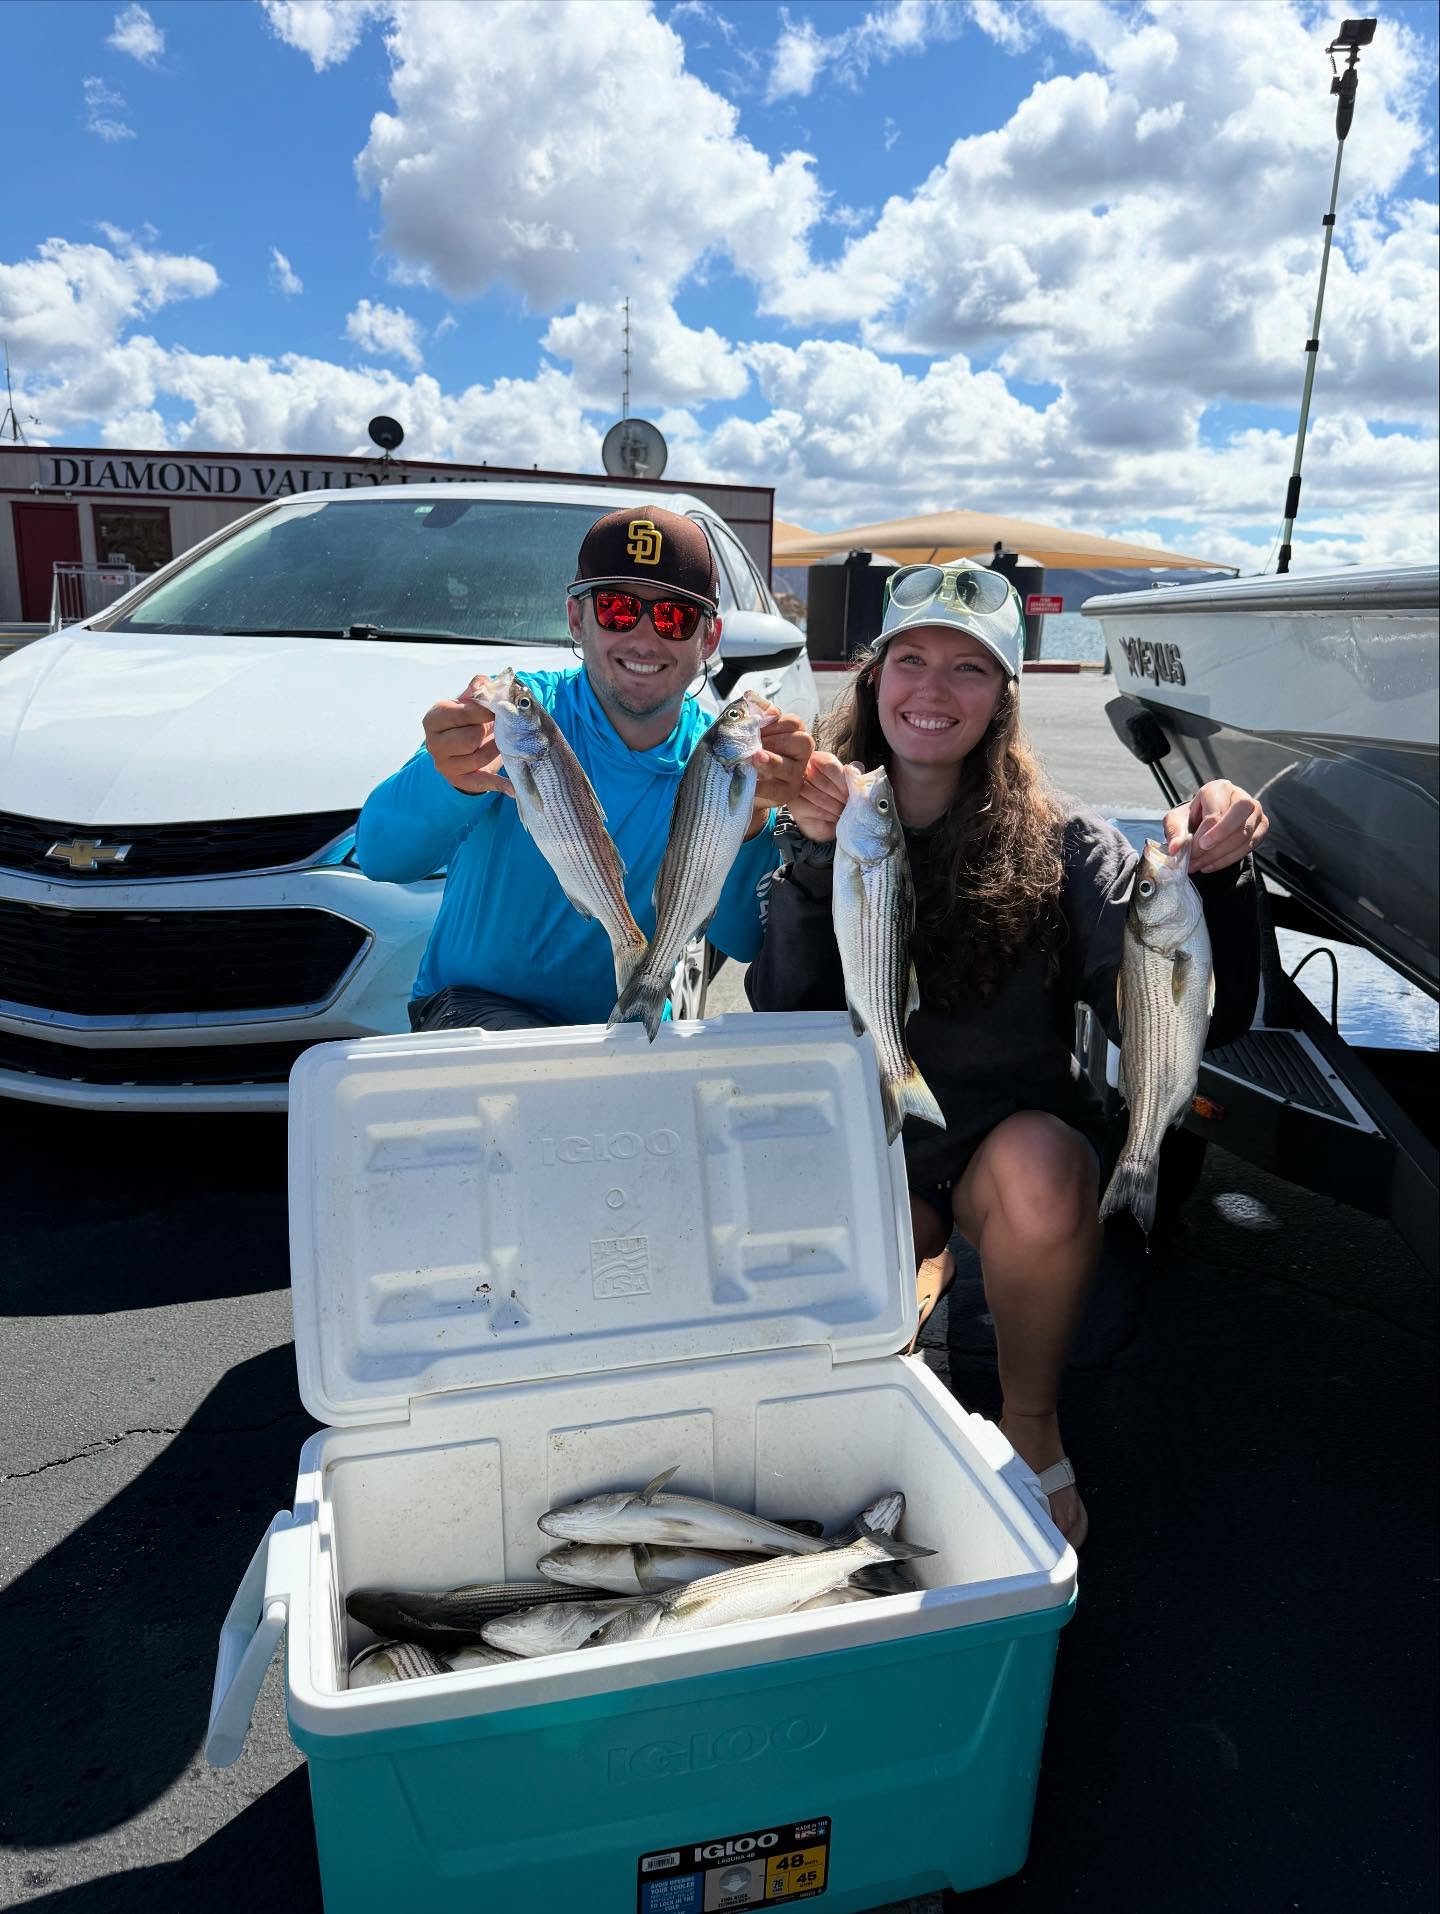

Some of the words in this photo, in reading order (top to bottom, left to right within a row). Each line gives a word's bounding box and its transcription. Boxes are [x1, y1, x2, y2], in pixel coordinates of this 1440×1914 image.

[49, 457, 242, 494] DIAMOND
[626, 520, 662, 565] SD
[542, 1128, 681, 1167] IGLOO
[607, 1716, 829, 1784] IGLOO
[694, 1833, 779, 1862] IGLOO
[717, 1853, 745, 1865] LAGUNA
[776, 1854, 804, 1870] 48
[796, 1871, 817, 1882] 45
